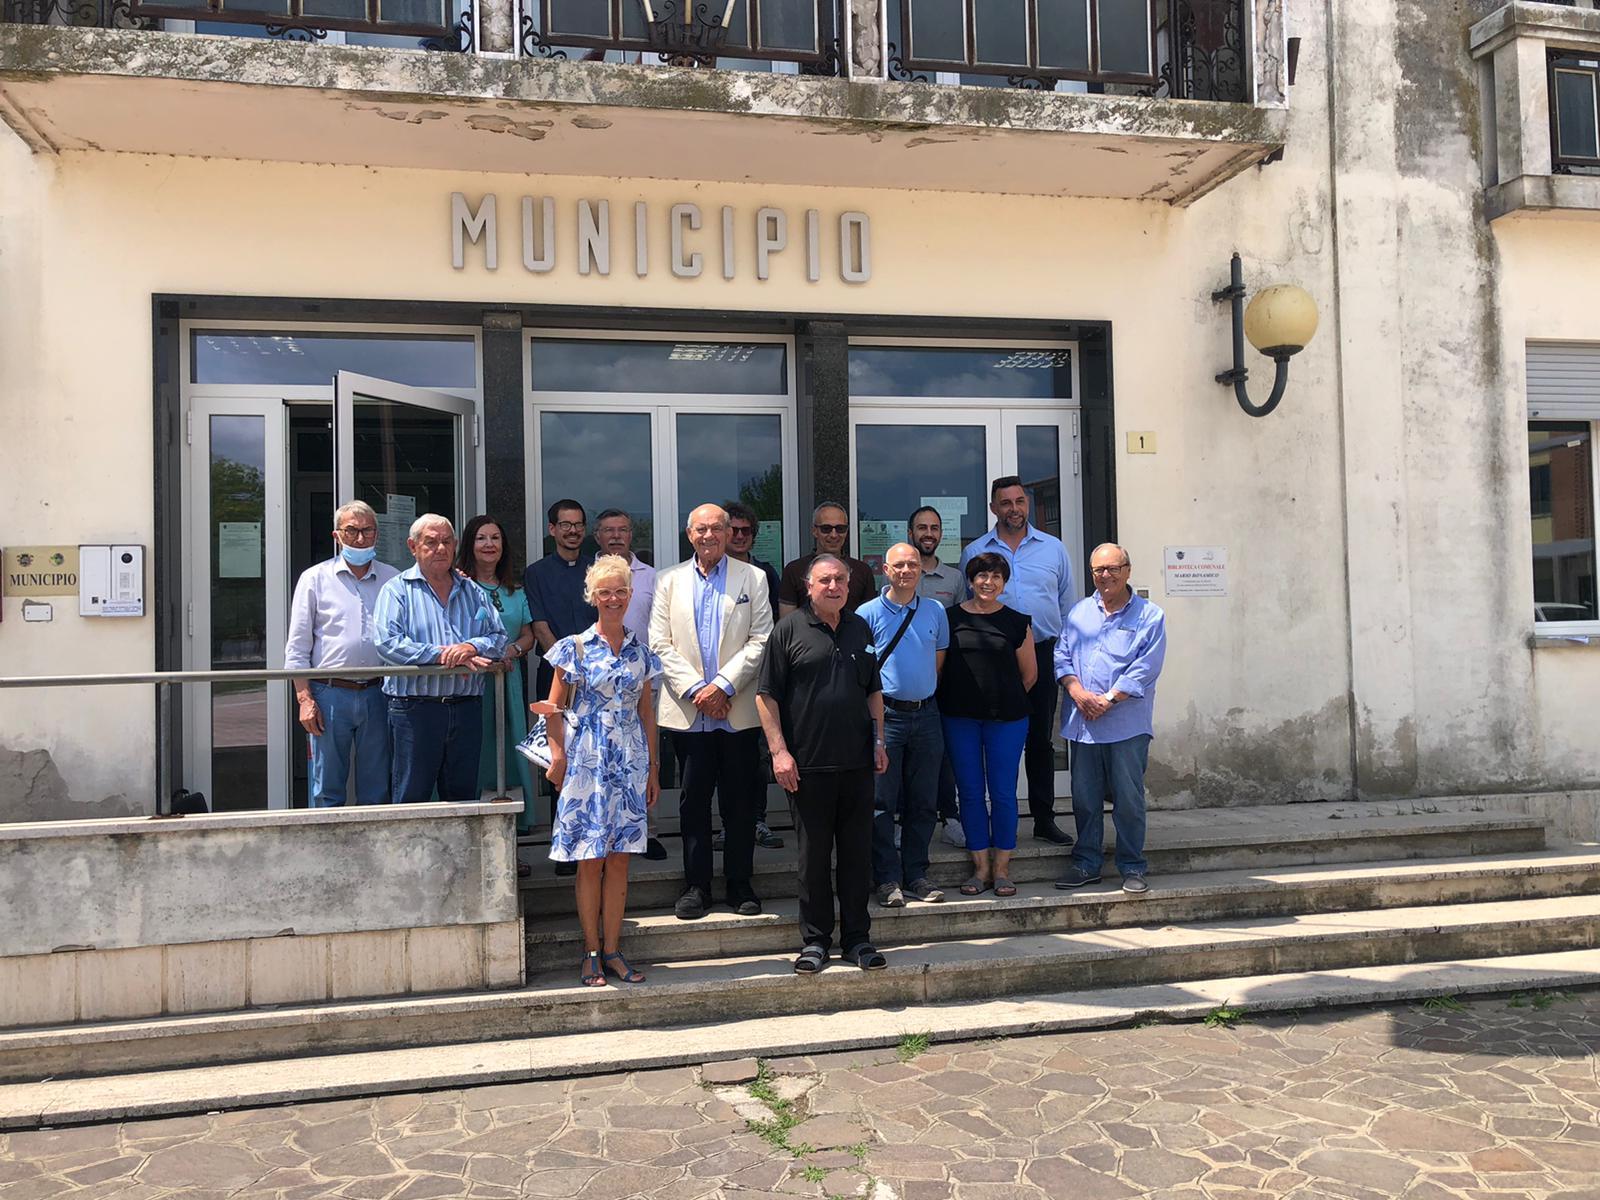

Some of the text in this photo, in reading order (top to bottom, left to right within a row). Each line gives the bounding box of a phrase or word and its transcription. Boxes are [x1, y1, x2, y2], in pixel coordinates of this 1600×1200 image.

[450, 191, 871, 284] MUNICIPIO
[1140, 436, 1144, 449] 1
[10, 573, 77, 587] MUNICIPIO
